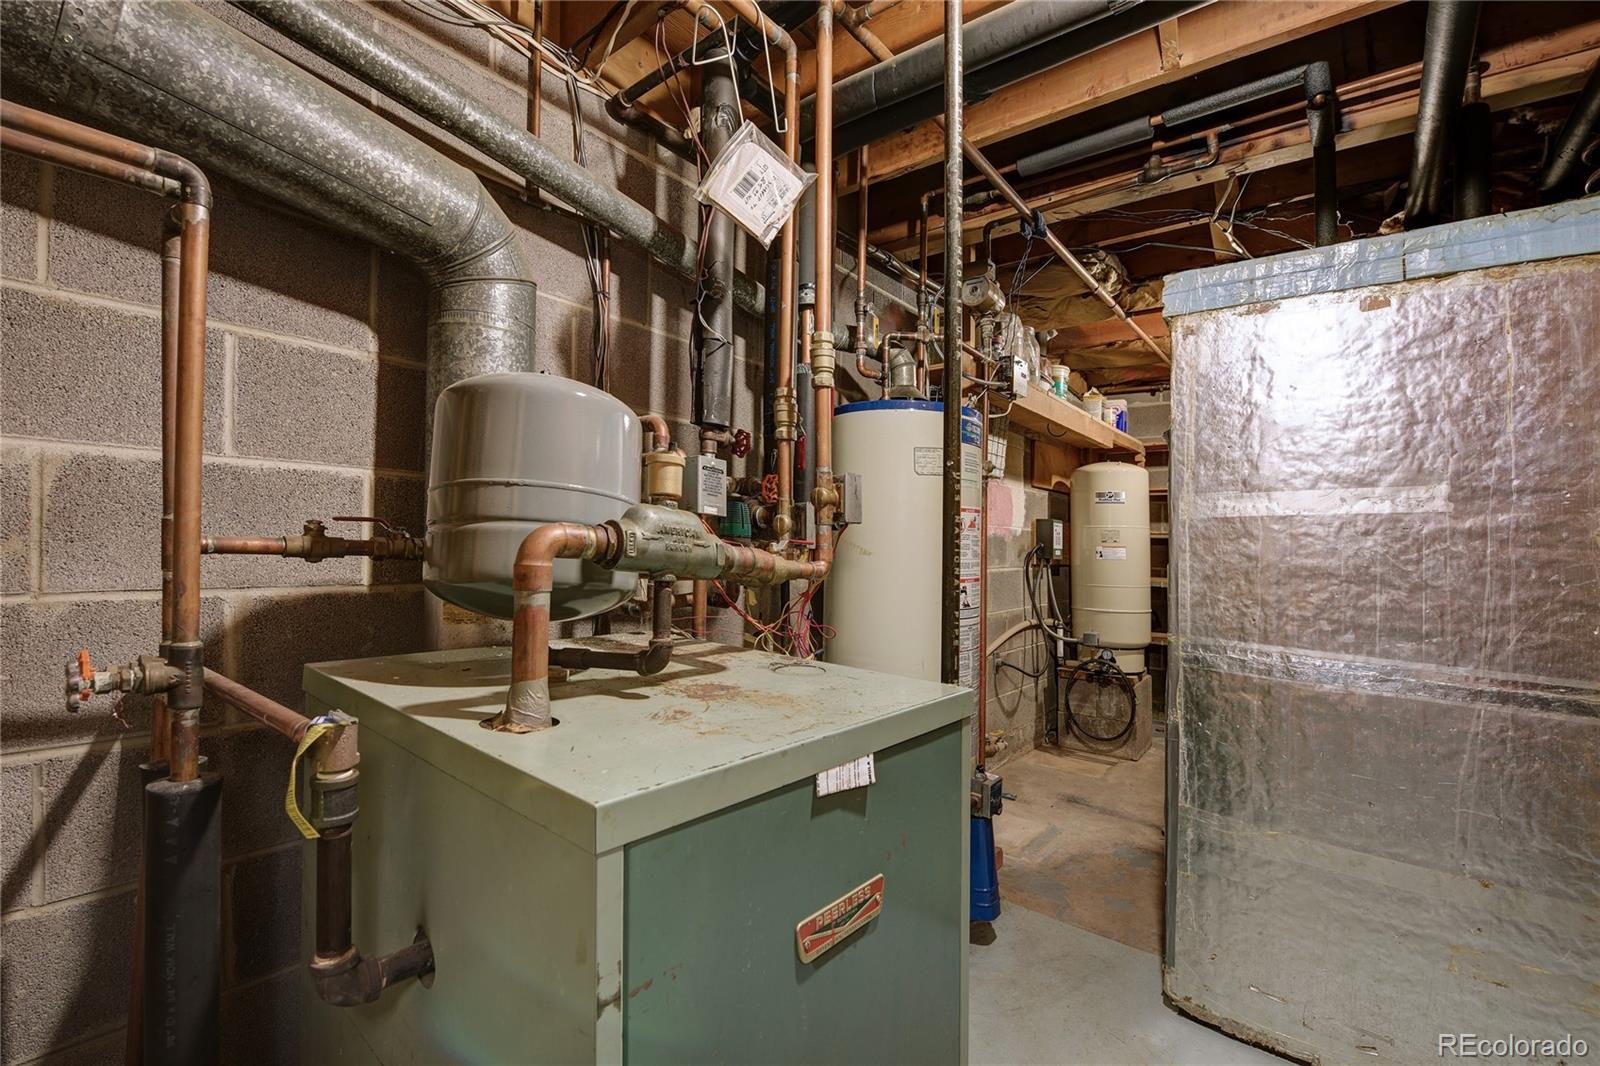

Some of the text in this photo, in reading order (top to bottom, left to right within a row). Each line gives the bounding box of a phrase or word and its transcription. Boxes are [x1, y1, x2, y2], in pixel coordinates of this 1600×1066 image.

[956, 300, 962, 314] IN
[815, 886, 871, 930] PEERLESS
[165, 923, 176, 952] WALL
